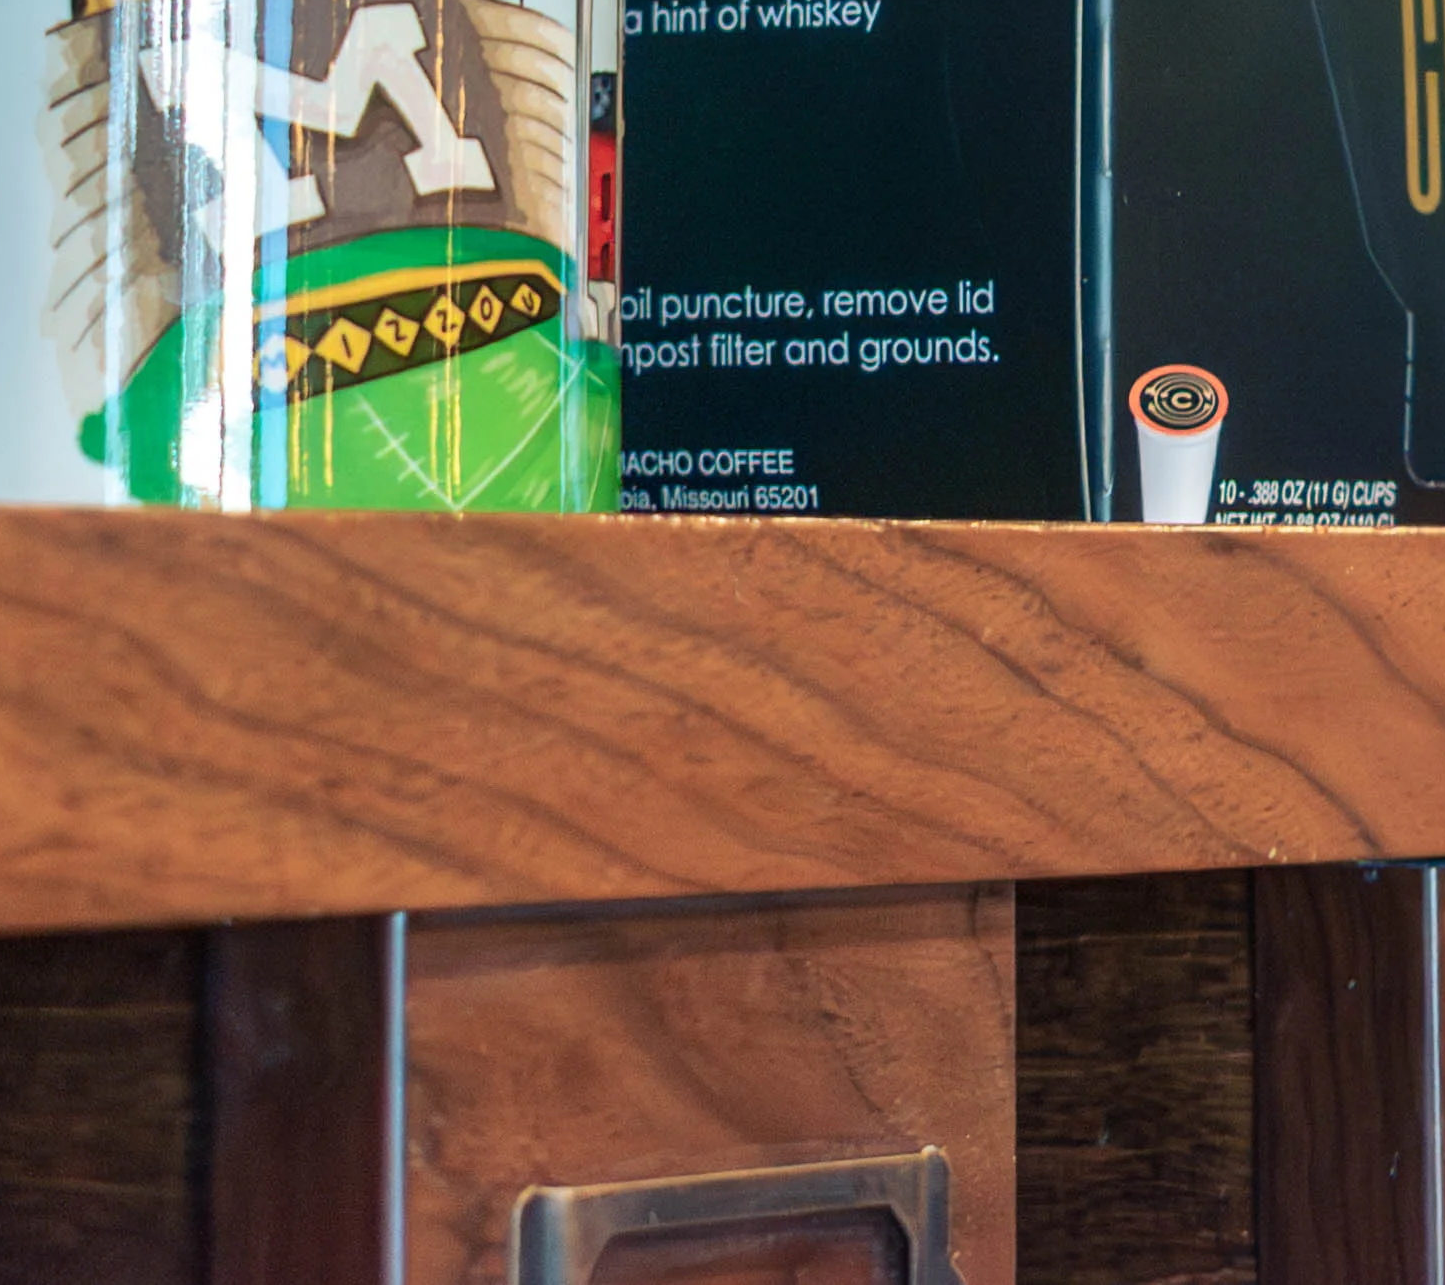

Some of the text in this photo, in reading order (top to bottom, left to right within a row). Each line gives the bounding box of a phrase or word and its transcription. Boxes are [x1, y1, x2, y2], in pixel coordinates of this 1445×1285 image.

[651, 0, 710, 33] hint
[621, 279, 995, 326] oil puncture, remove lid
[710, 332, 776, 367] filter
[785, 331, 848, 366] and
[860, 329, 1000, 372] grounds.
[699, 448, 794, 475] COFFEE
[662, 486, 749, 511] Missouri
[756, 485, 819, 510] 65201
[1219, 480, 1236, 505] 10
[1248, 481, 1279, 505] .388
[1282, 481, 1305, 505] OZ
[1307, 481, 1328, 510] (11
[1332, 481, 1350, 510] G)
[1353, 481, 1398, 507] CUPS
